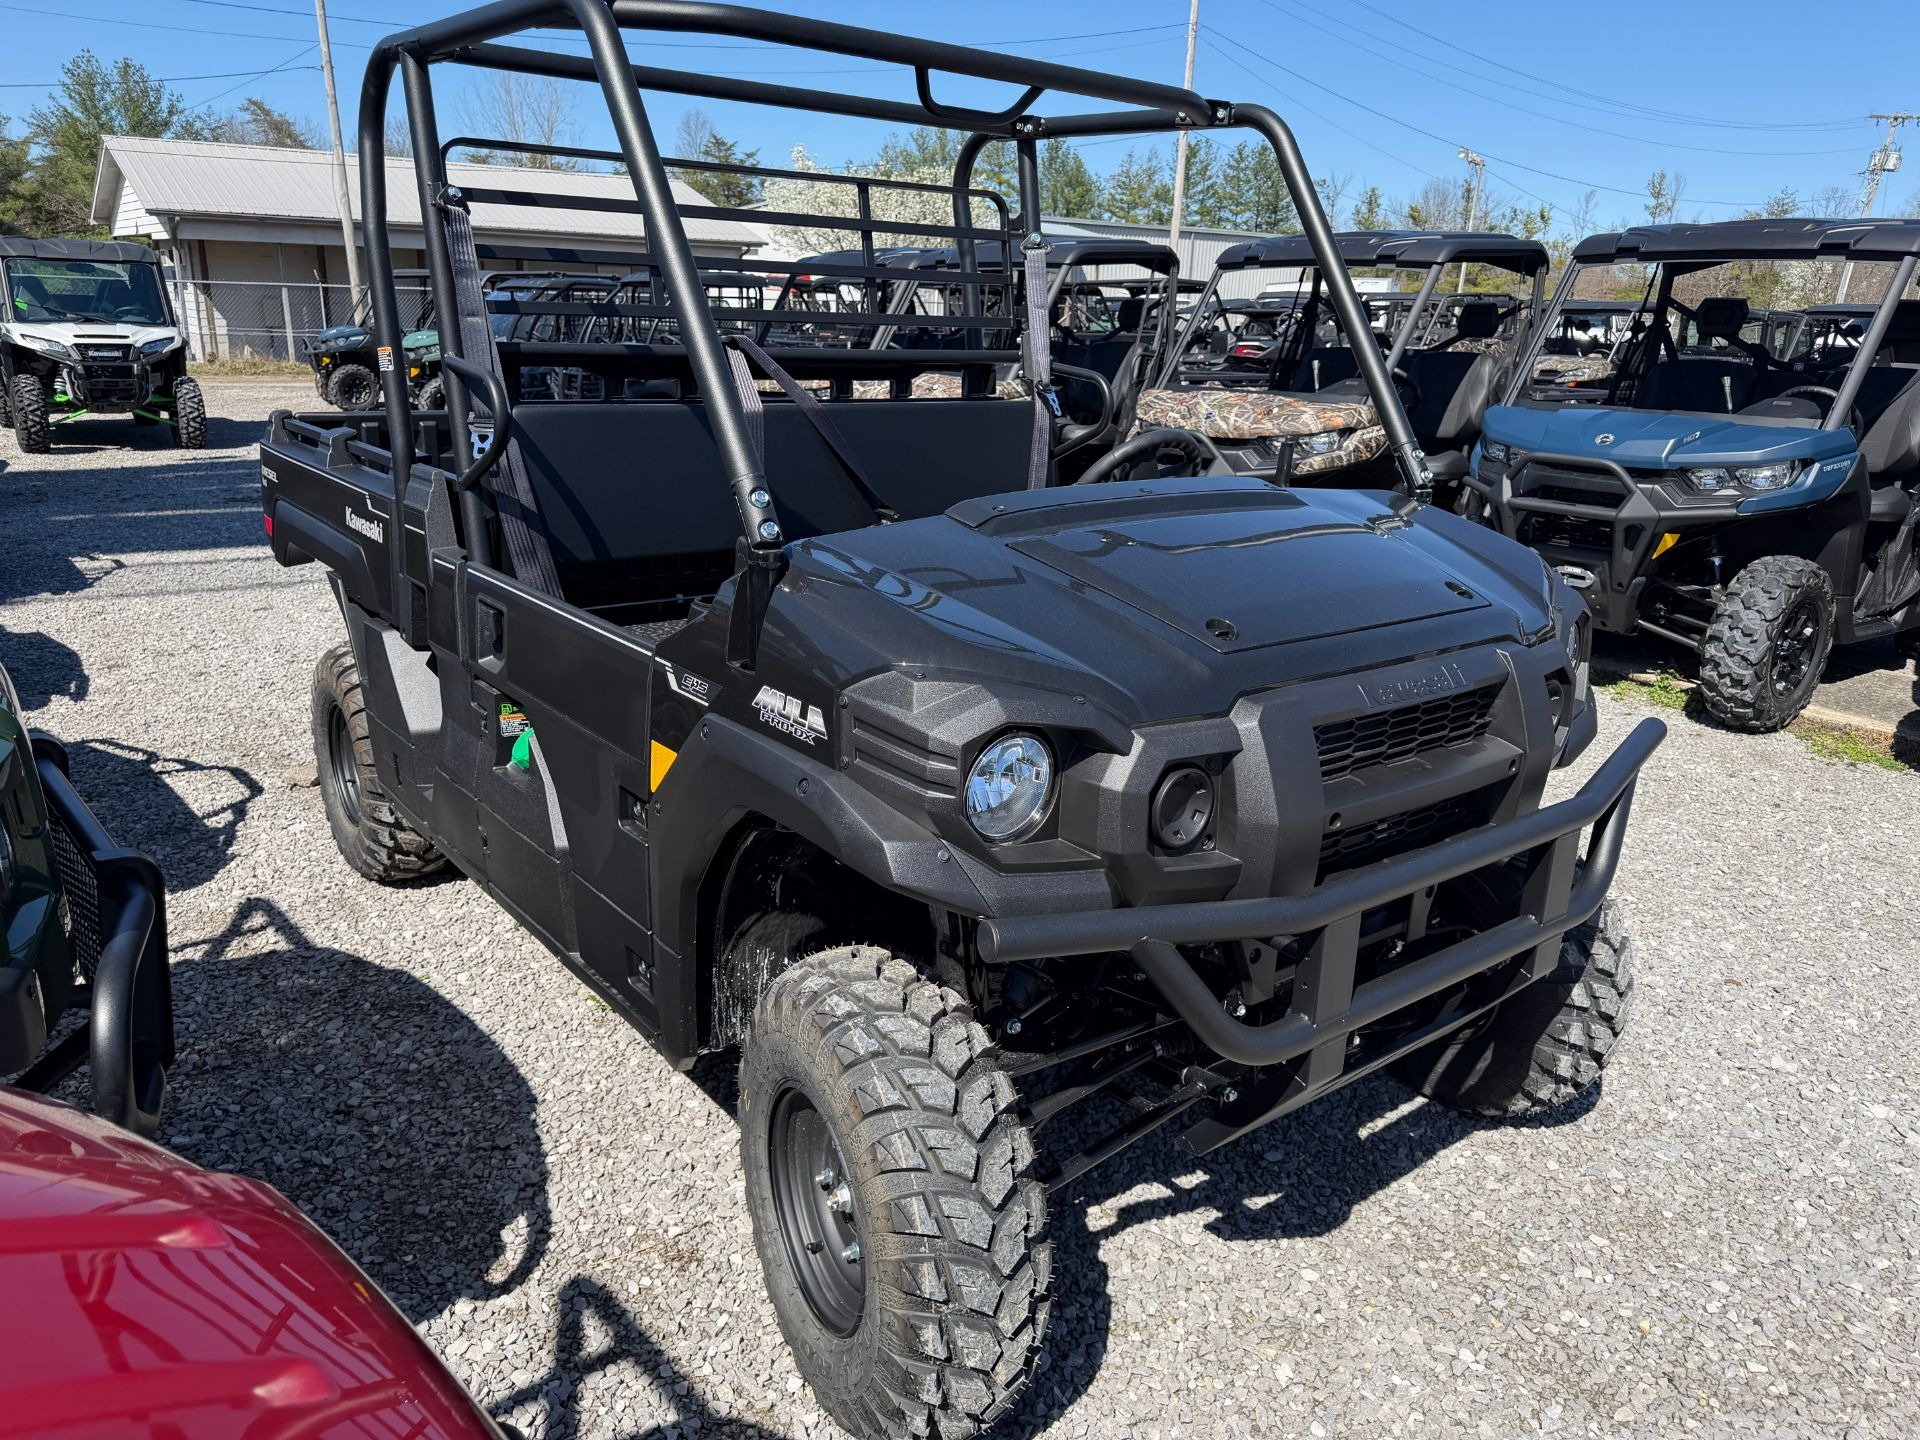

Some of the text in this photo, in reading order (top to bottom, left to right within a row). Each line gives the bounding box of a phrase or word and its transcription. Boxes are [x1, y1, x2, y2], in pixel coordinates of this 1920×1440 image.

[345, 505, 383, 544] Kawasaki
[681, 673, 709, 694] EPS
[752, 685, 828, 740] MULE
[760, 710, 816, 746] PRO-DX
